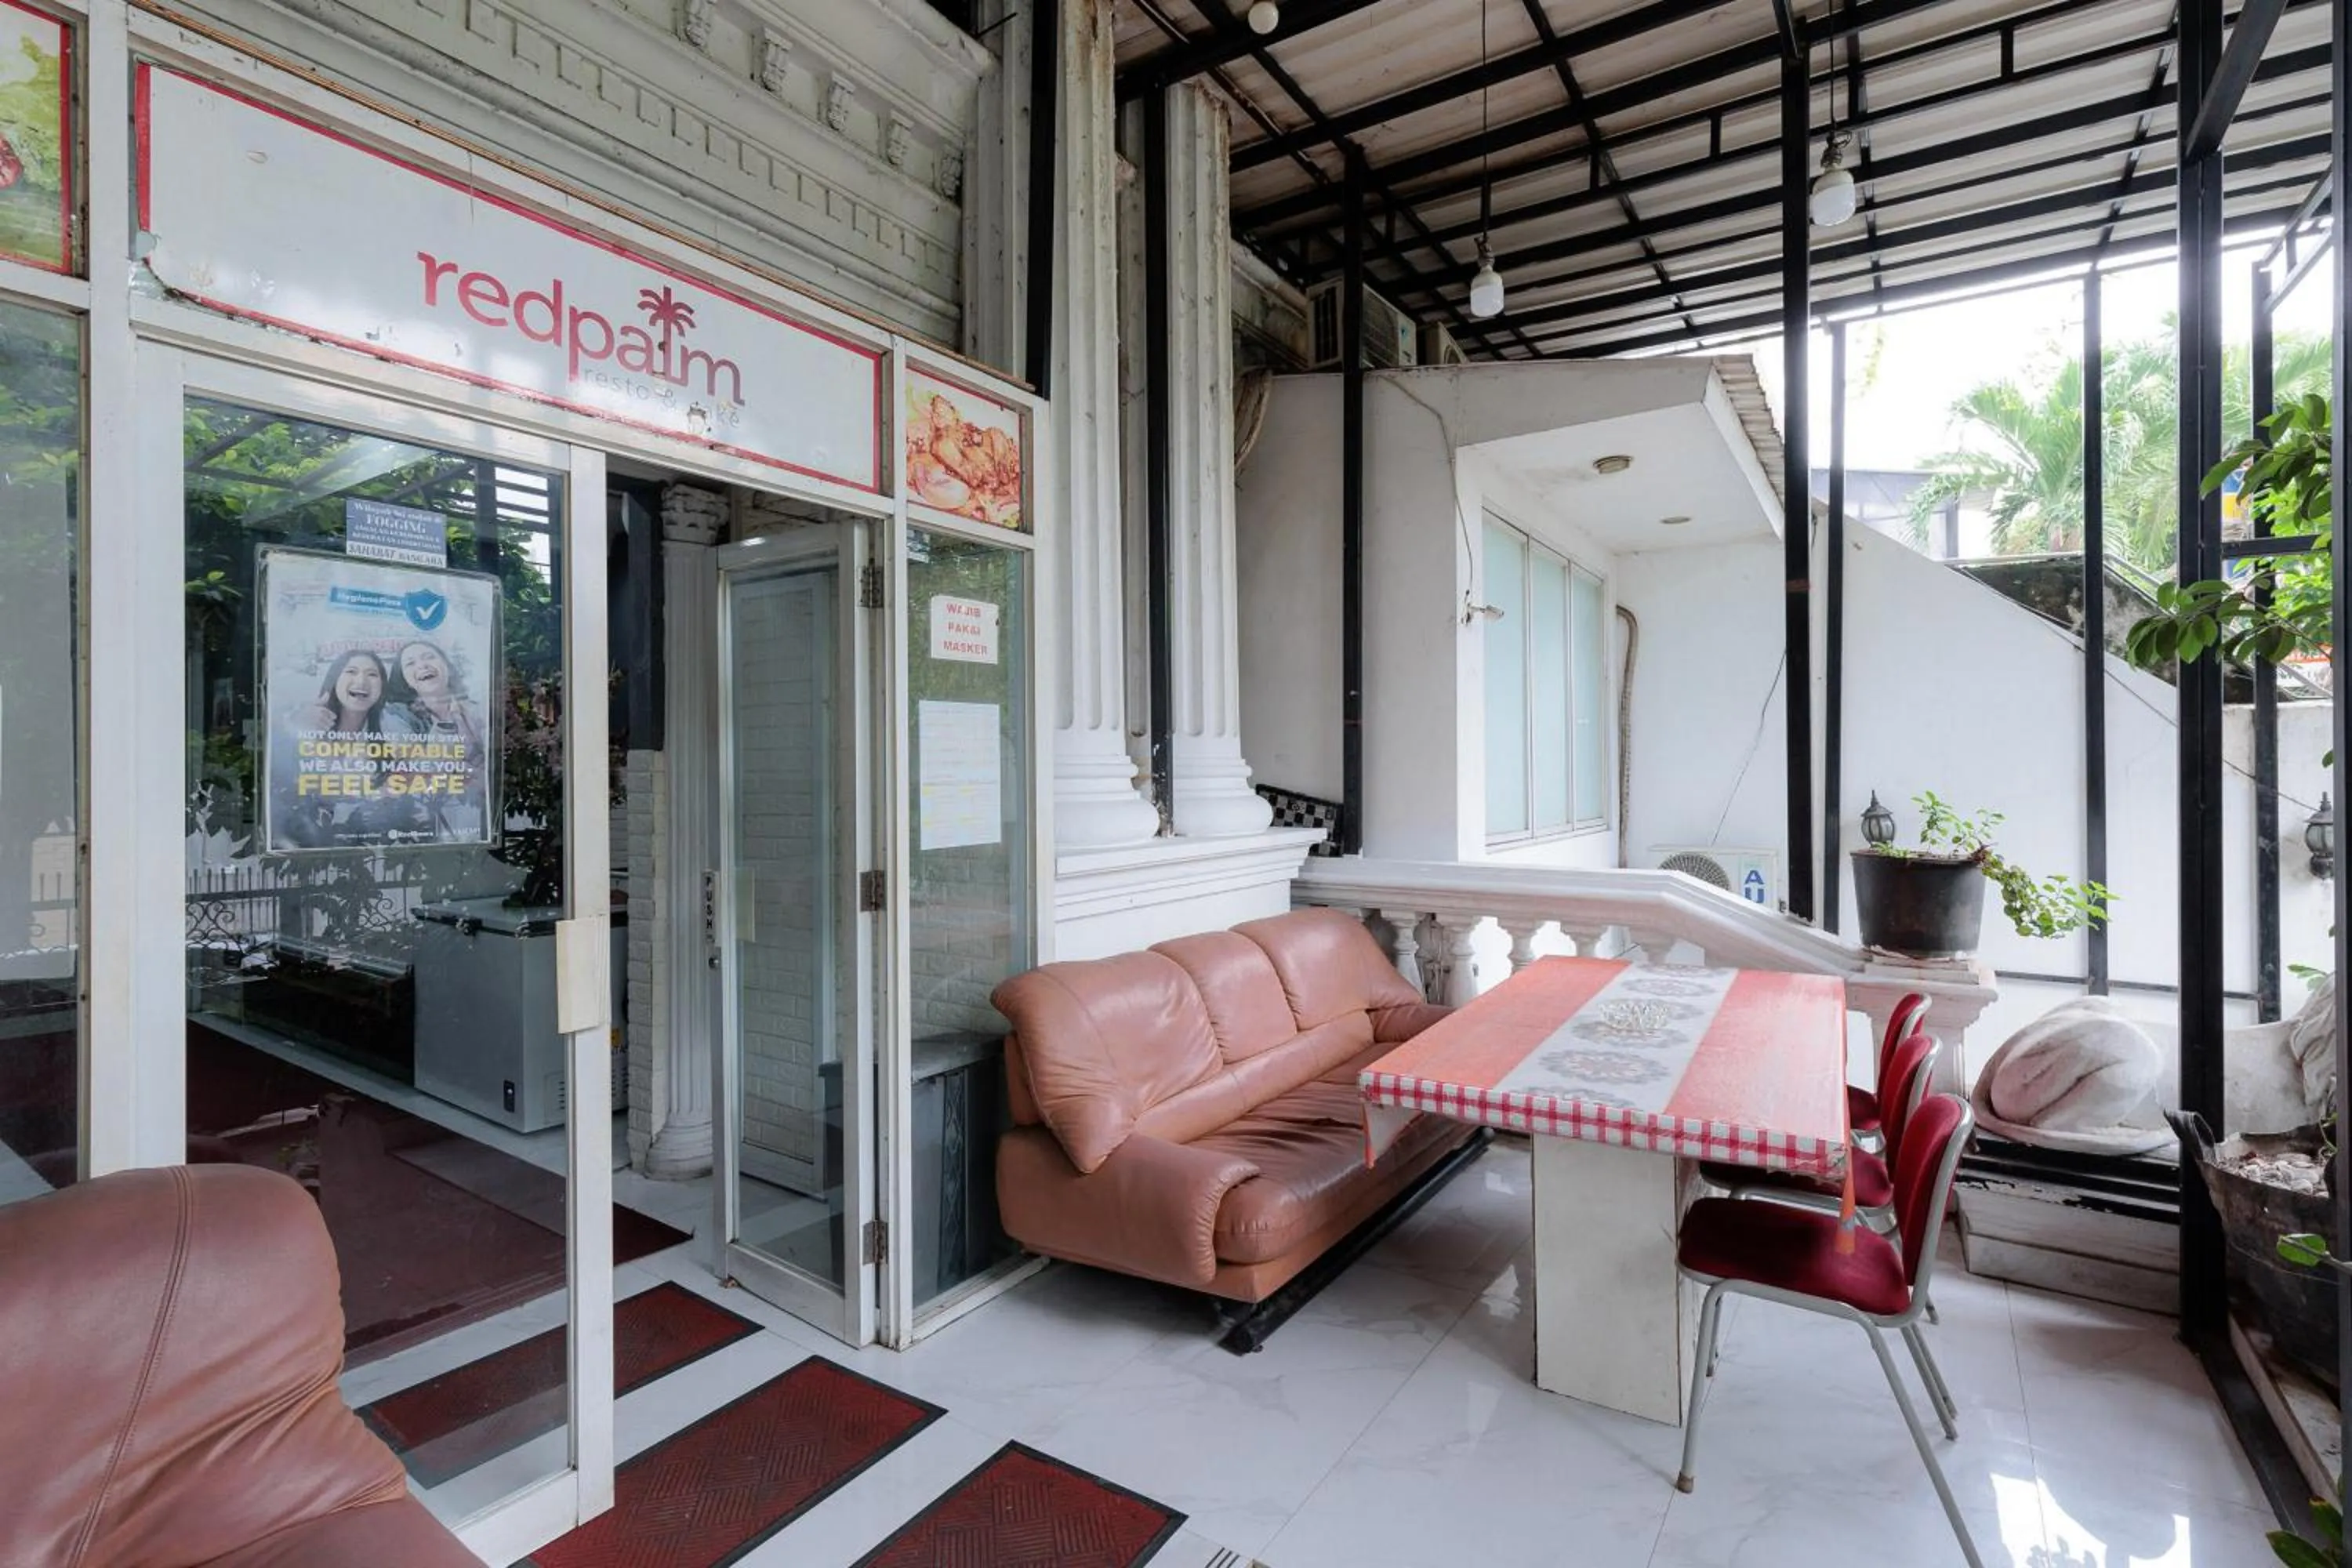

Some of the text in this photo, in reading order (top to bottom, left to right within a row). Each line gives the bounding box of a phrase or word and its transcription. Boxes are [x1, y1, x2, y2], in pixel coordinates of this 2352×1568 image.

[417, 251, 746, 406] redpalm
[584, 368, 650, 401] resto
[943, 640, 988, 655] MASKER
[328, 731, 361, 741] ONLY
[364, 732, 399, 742] MAKE
[402, 734, 434, 742] YOUR
[299, 741, 466, 758] COMFORTABLE
[299, 759, 327, 772] WE
[331, 759, 377, 772] ALSO
[381, 760, 430, 772] MAKE
[298, 773, 466, 797] FEEL SAFE
